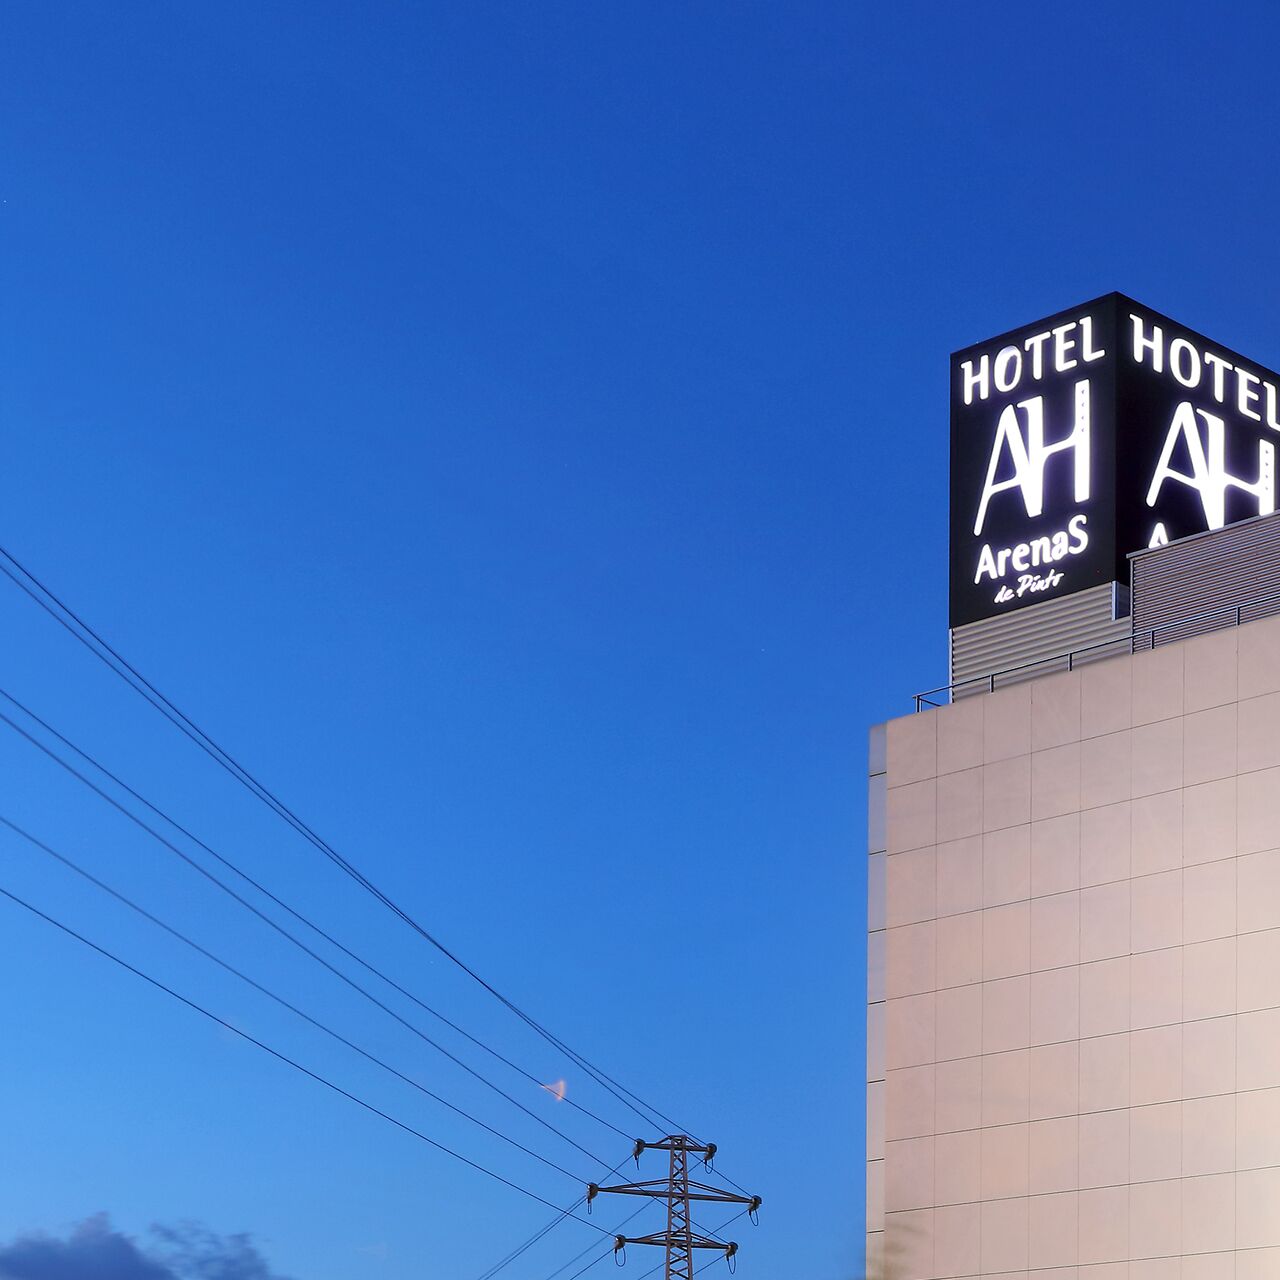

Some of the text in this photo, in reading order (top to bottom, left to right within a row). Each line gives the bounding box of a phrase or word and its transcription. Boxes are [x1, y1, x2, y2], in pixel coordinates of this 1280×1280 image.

[960, 316, 1105, 406] HOTEL
[973, 378, 1090, 537] AH
[1146, 401, 1275, 531] AH
[994, 568, 1065, 604] de Pinto
